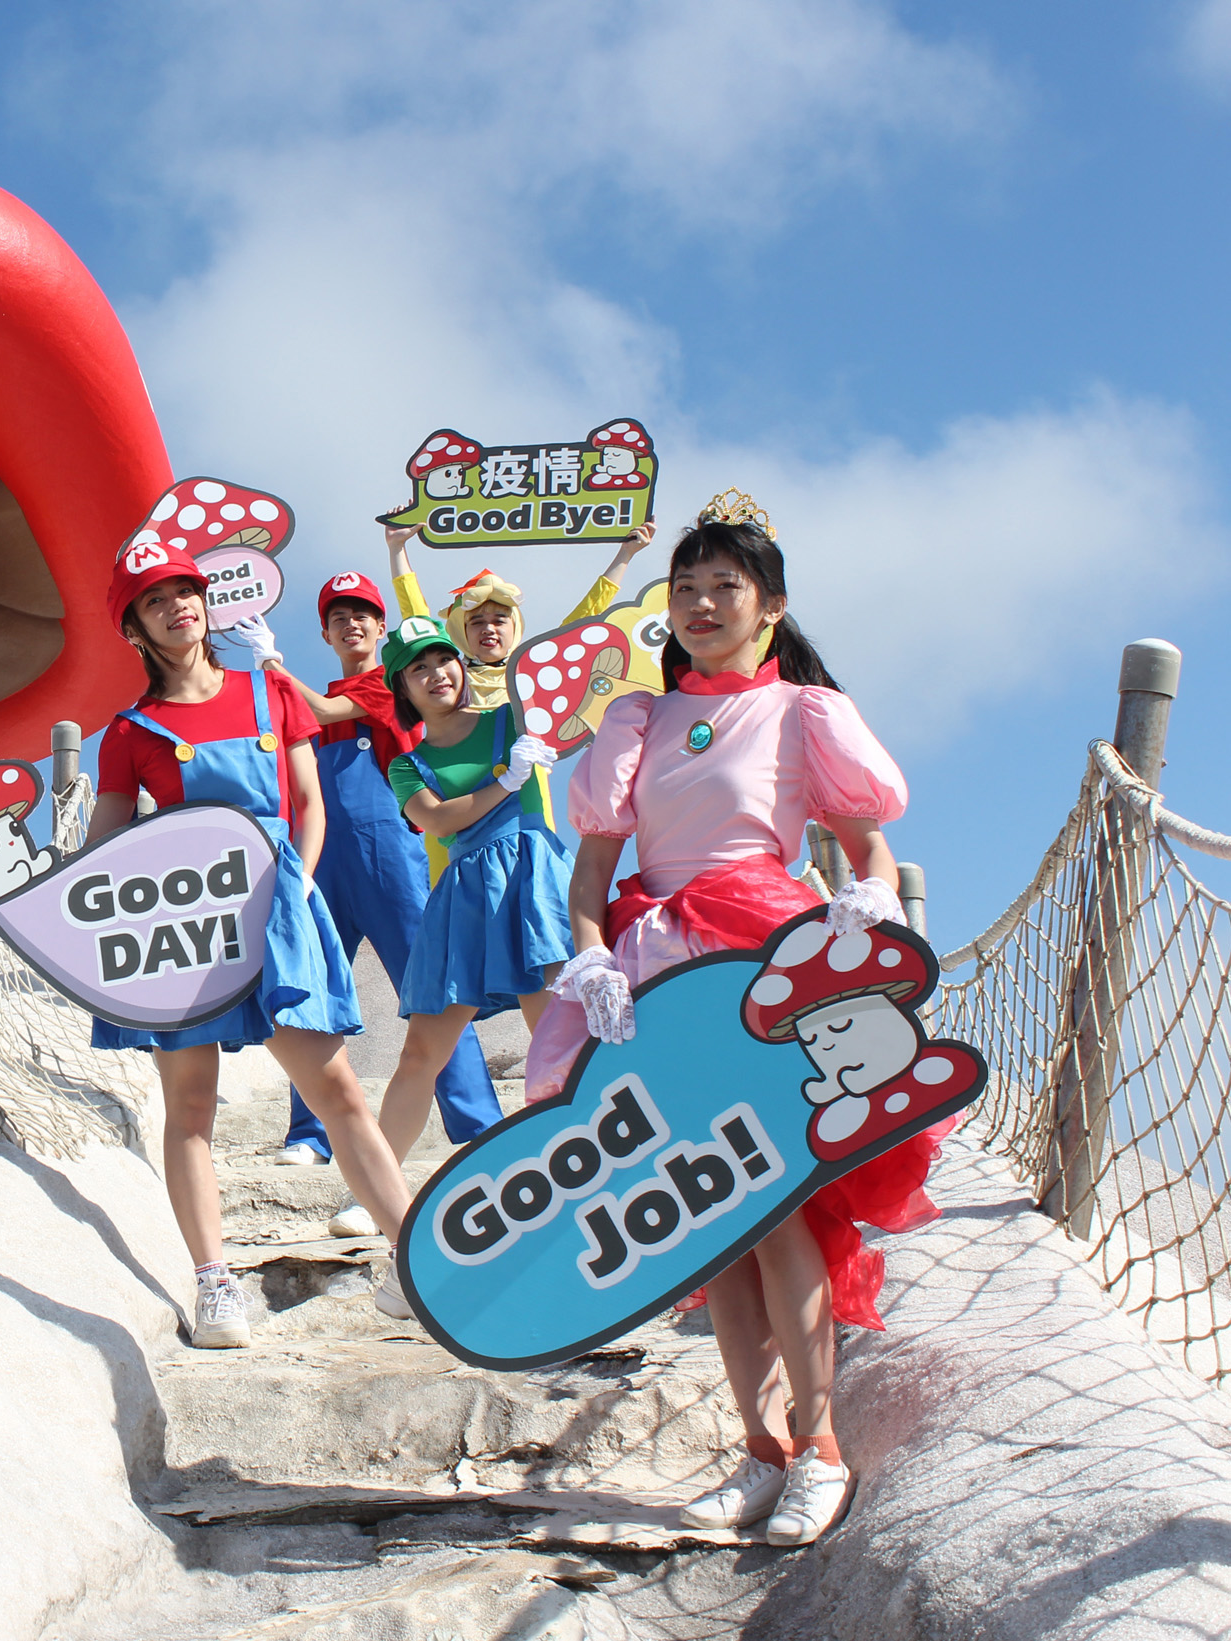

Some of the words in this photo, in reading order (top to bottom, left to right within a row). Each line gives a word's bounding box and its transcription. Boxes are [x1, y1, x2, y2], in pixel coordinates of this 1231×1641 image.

[480, 447, 582, 498] 疫情
[428, 503, 532, 534] Good
[540, 498, 633, 535] Bye!
[134, 546, 161, 568] M
[201, 562, 251, 585] ood
[207, 581, 264, 607] lace!
[336, 574, 355, 587] M
[410, 621, 430, 636] L
[639, 615, 673, 648] G
[67, 848, 250, 923] Good
[98, 912, 241, 983] DAY!
[441, 1085, 658, 1256] Good
[584, 1114, 772, 1280] Job!
